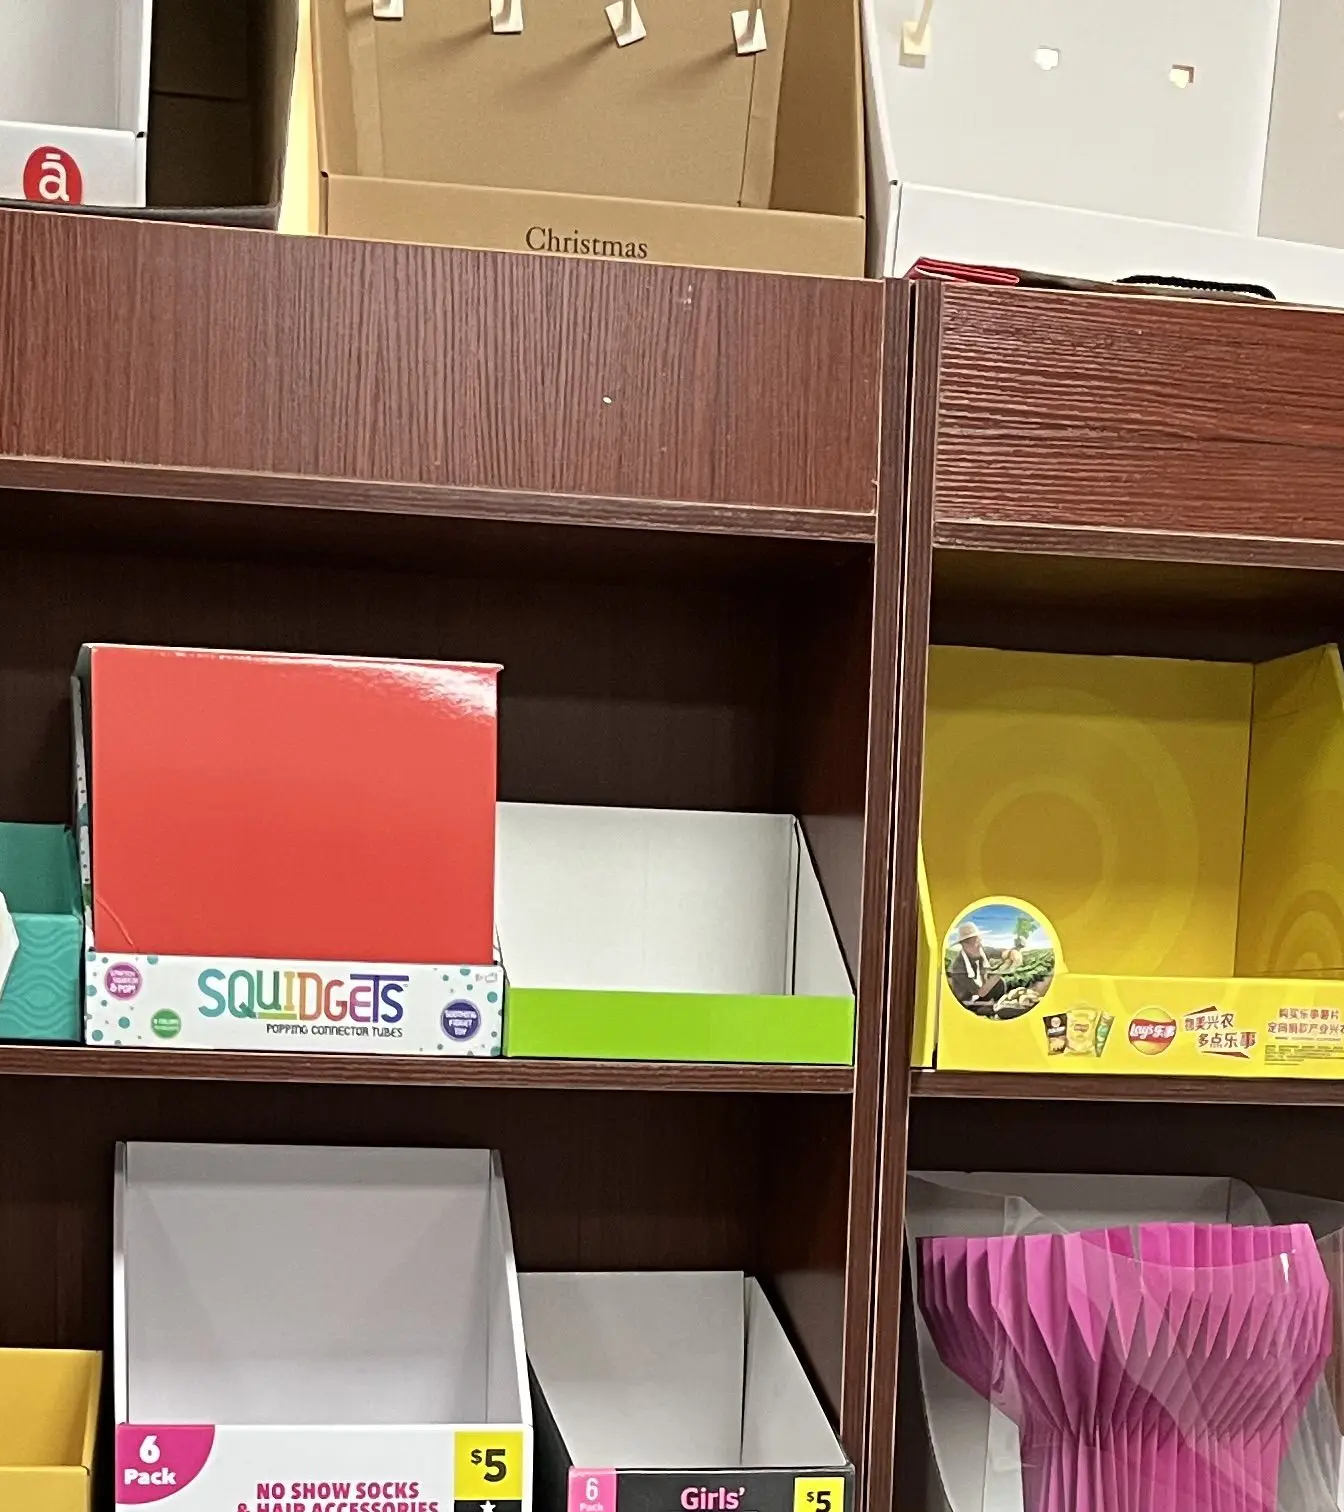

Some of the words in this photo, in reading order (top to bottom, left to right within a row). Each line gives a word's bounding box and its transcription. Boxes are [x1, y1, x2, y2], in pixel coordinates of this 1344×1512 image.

[525, 226, 649, 260] Christmas
[197, 968, 410, 1024] SQUIDGETS
[266, 1023, 308, 1035] POPPING
[311, 1025, 369, 1037] CONNECTOR
[372, 1025, 403, 1038] TUBES
[138, 1433, 161, 1464] 6
[123, 1467, 177, 1487] Pack
[470, 1447, 508, 1483] $5
[256, 1482, 286, 1500] NO
[291, 1482, 352, 1500] SHOW
[355, 1481, 420, 1500] SOCKS
[585, 1477, 599, 1501] 6
[579, 1502, 604, 1512] Pack
